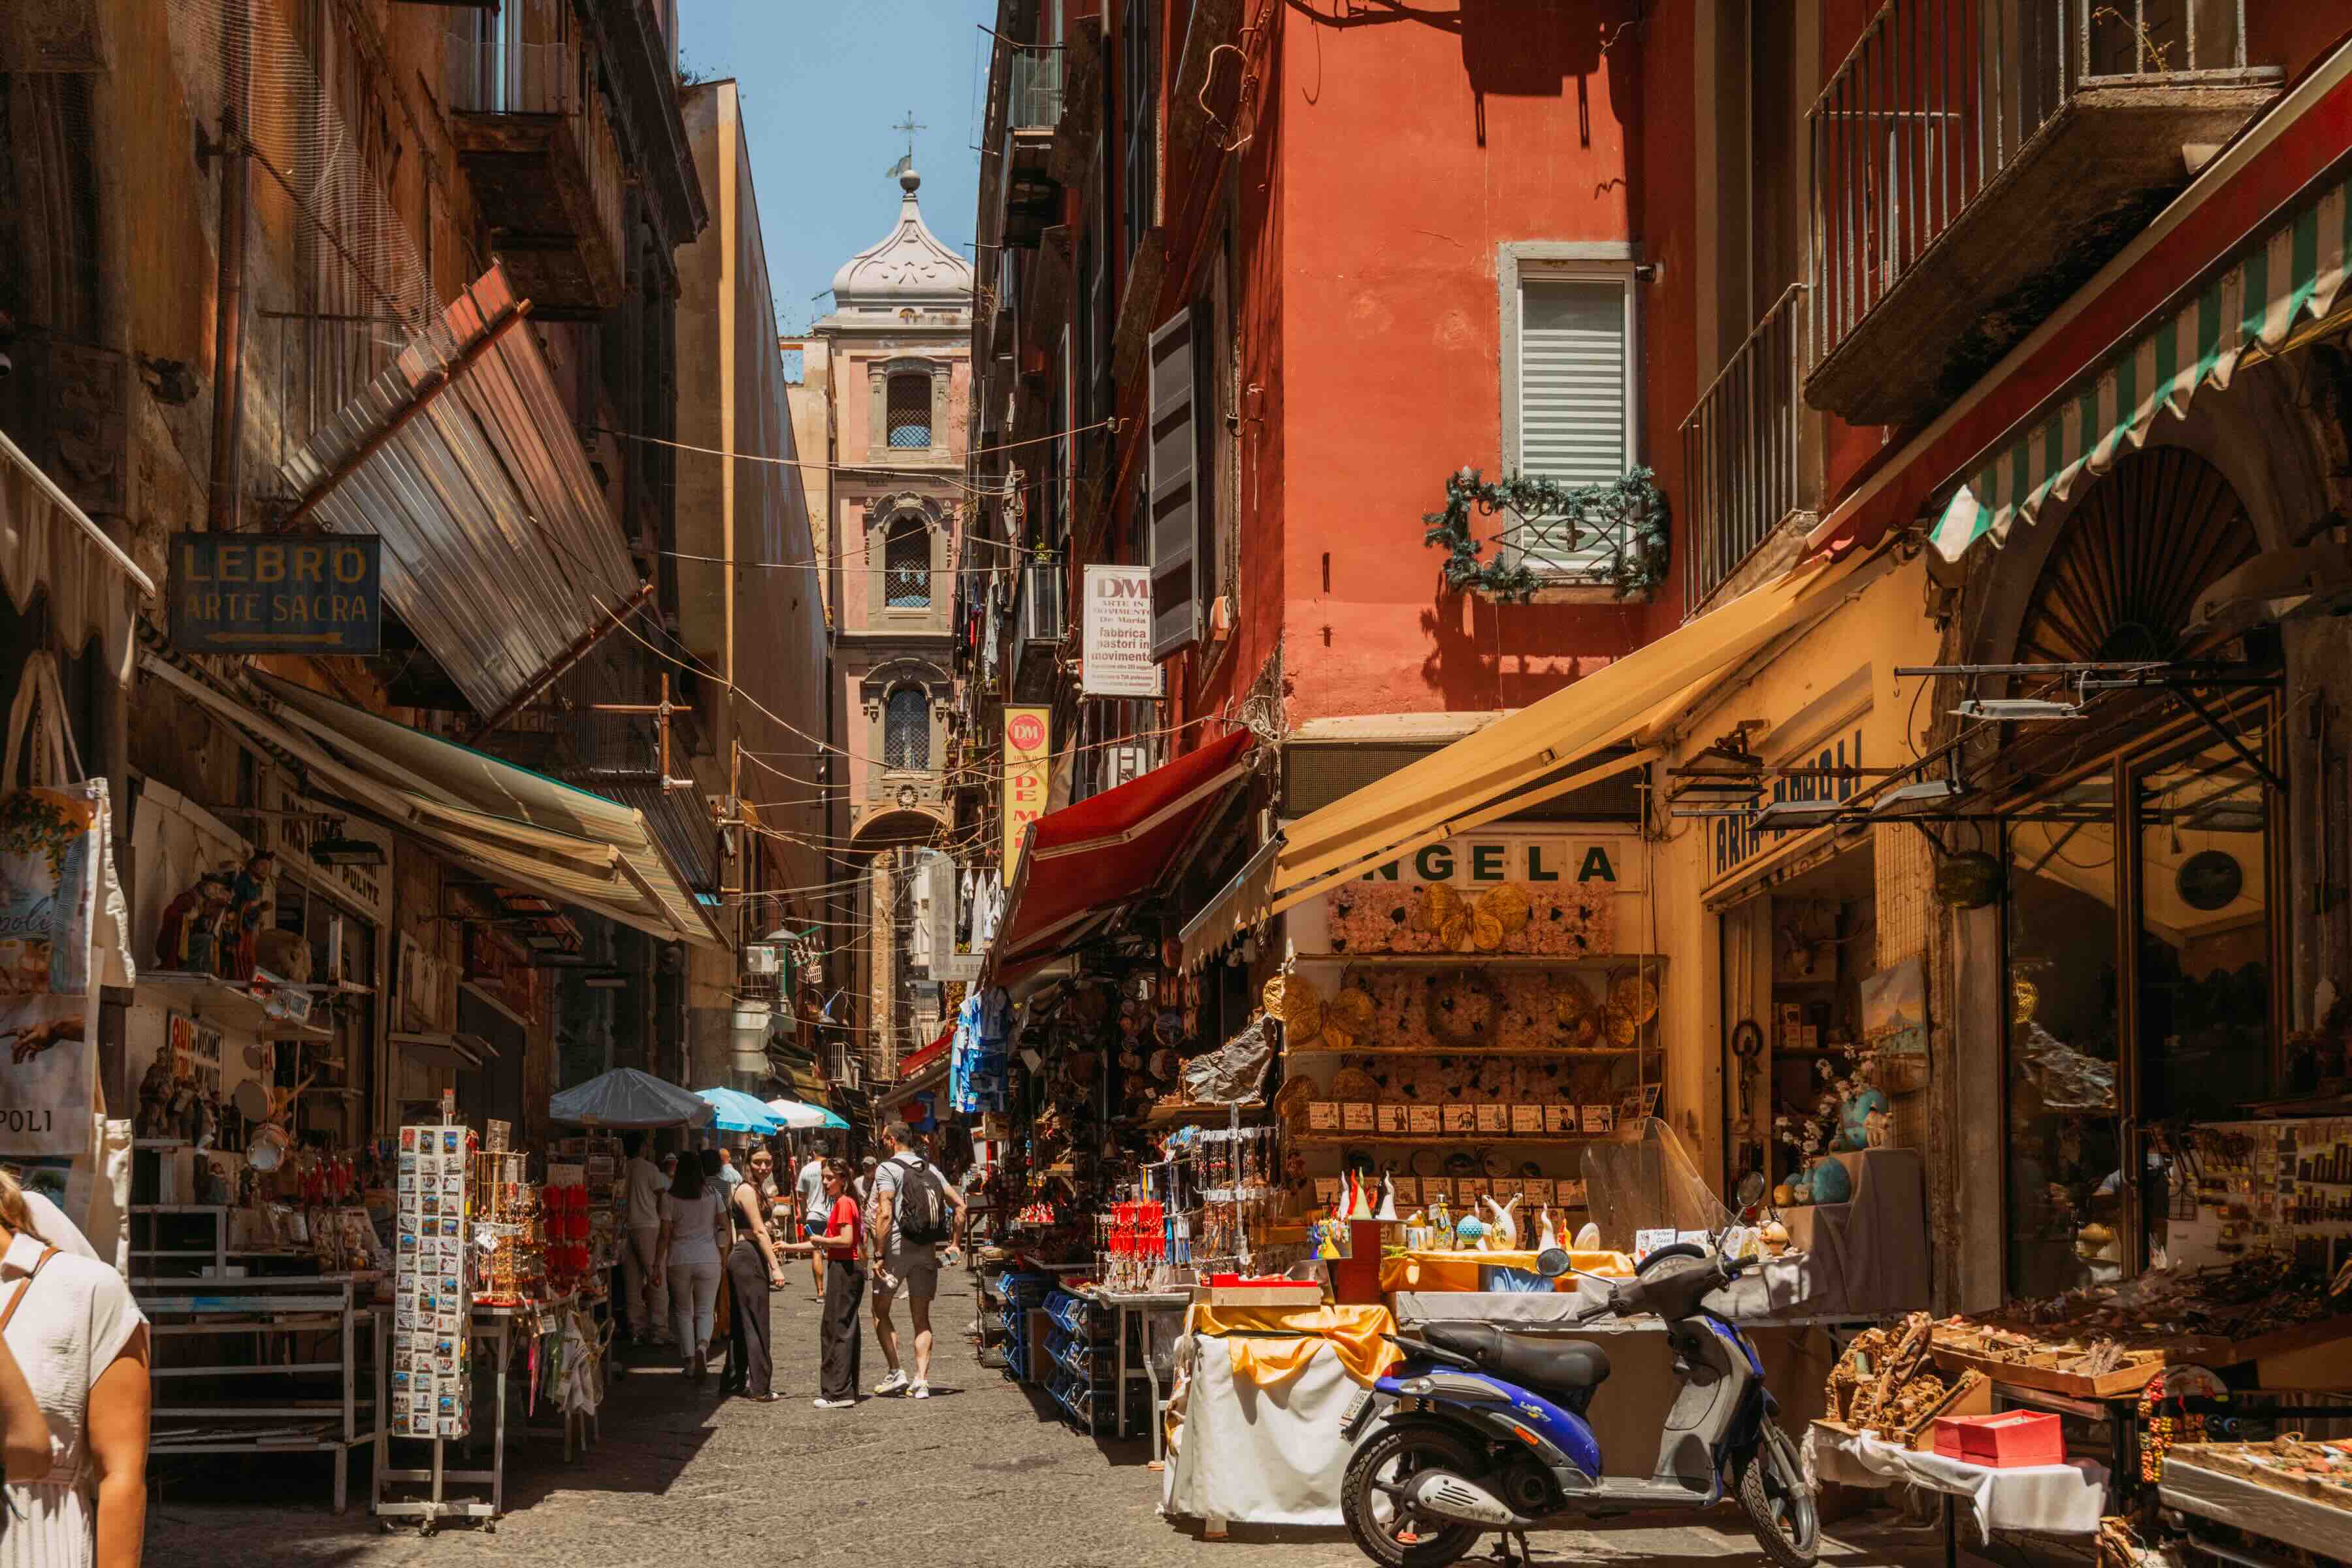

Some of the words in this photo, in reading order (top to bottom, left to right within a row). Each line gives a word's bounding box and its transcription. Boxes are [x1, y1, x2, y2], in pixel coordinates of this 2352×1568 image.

[183, 543, 367, 583] LEBRO
[1097, 578, 1149, 599] DM
[184, 593, 261, 623] ARTE
[272, 595, 367, 623] SACRA
[1100, 627, 1147, 638] fabbrica
[1097, 639, 1136, 650] pastori
[1139, 640, 1150, 649] in
[1013, 725, 1039, 740] DM
[1326, 844, 1617, 883] NGELA
